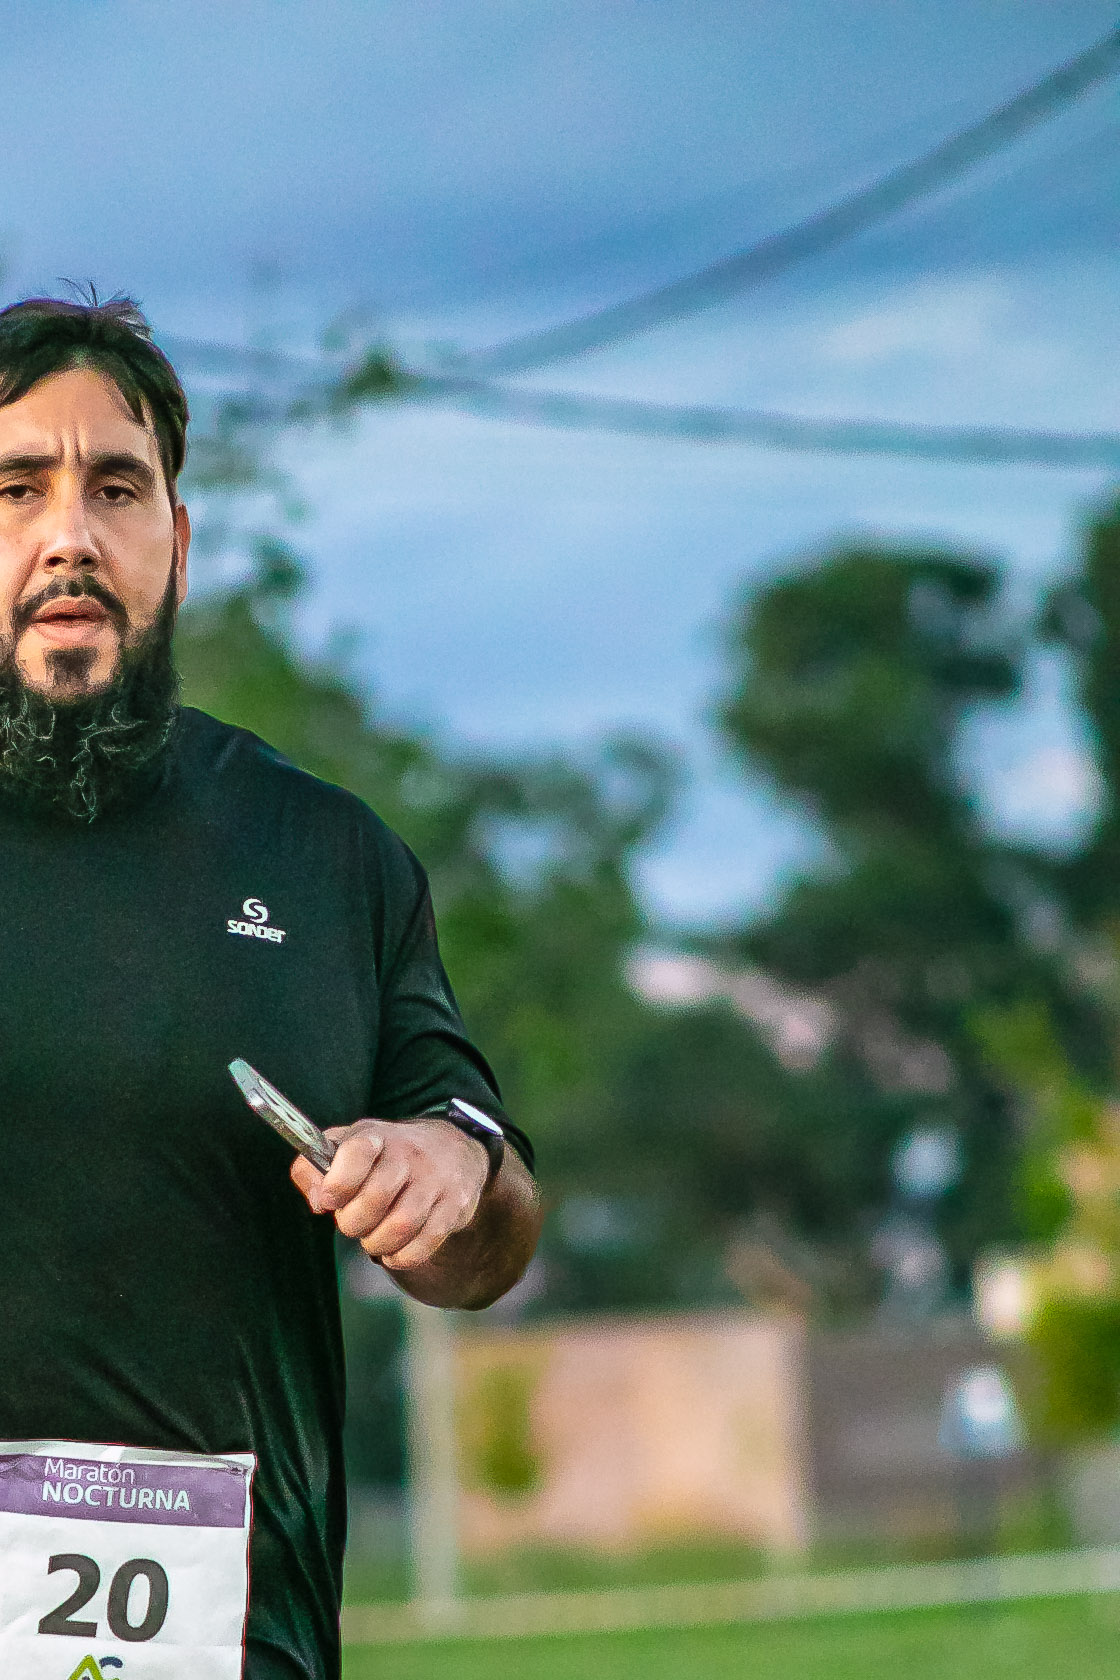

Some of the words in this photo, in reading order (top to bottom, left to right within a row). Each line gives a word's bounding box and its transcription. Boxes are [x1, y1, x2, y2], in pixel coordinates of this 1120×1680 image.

[44, 1457, 135, 1484] Maratón
[41, 1480, 190, 1511] NOCTURNA
[37, 1553, 169, 1642] 20
